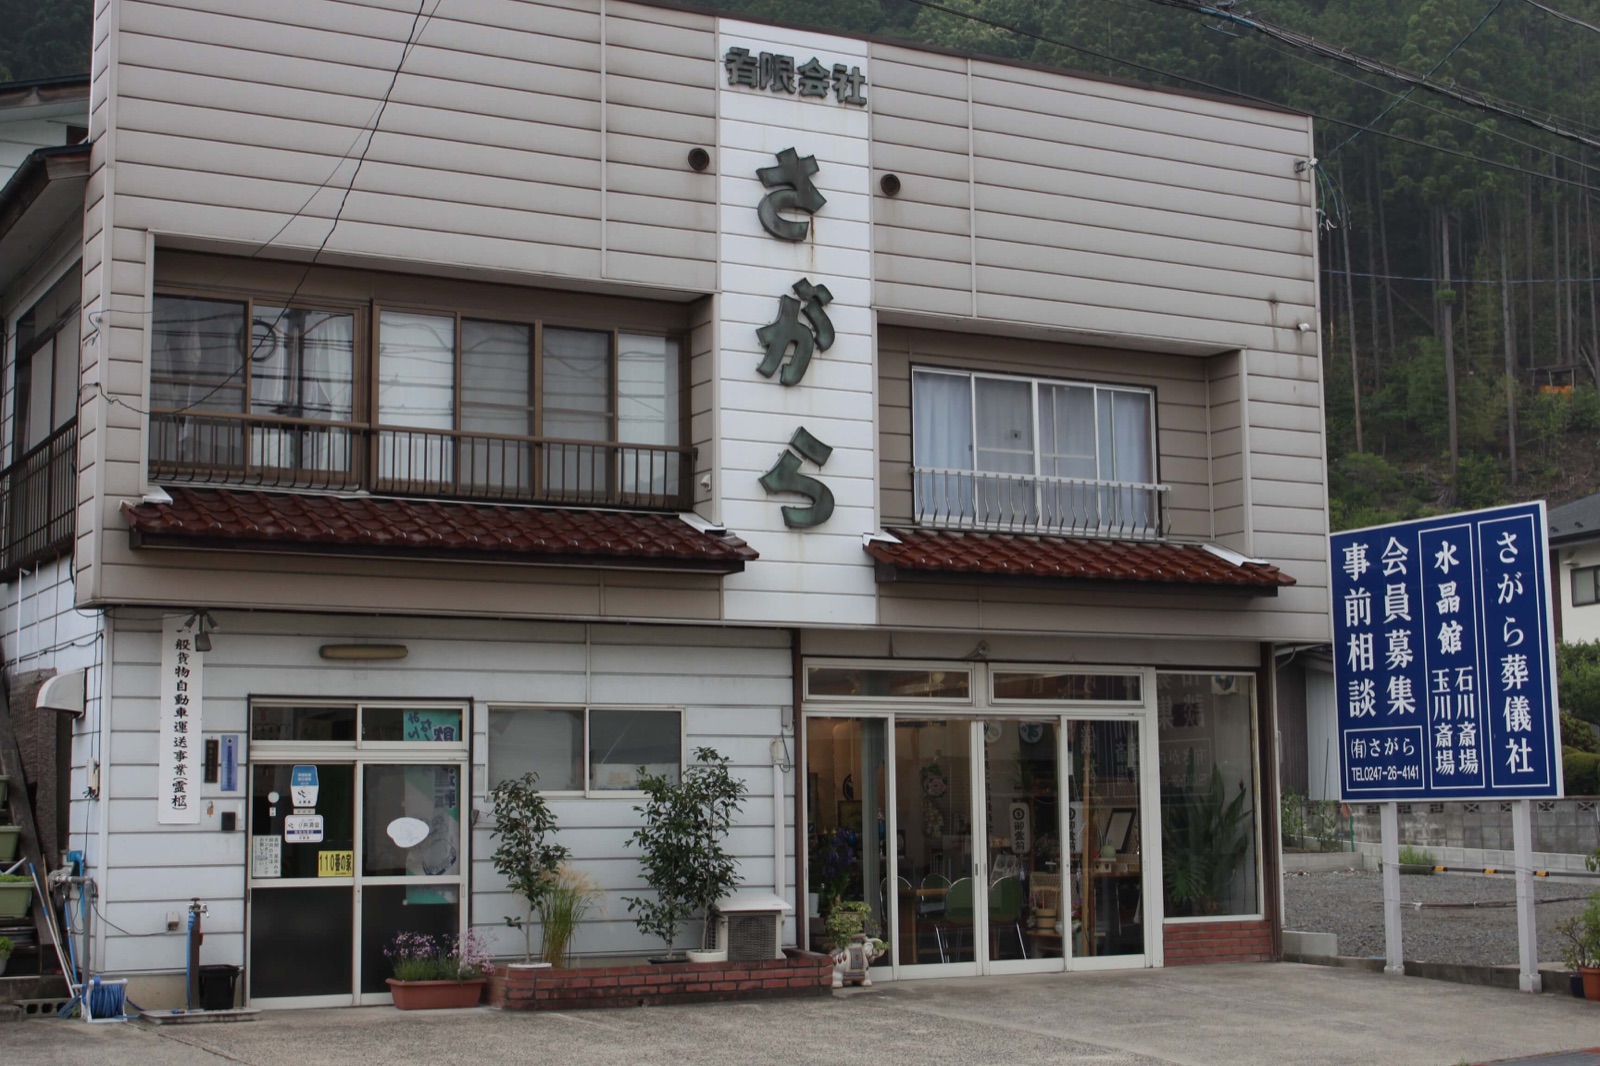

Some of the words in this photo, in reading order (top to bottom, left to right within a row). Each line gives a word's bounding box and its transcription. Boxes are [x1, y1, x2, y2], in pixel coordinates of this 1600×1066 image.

[725, 46, 868, 106] 有限会社
[755, 146, 836, 529] さがら
[1342, 542, 1377, 719] 事前相談
[1380, 536, 1416, 717] 会員募集
[1433, 540, 1463, 656] 水晶館
[1496, 531, 1534, 774] さがら葬儀社
[1351, 765, 1419, 782] TEL0247-26-4141
[1431, 668, 1455, 776] 玉川斎場
[1454, 665, 1479, 775] 石川斎場
[319, 853, 352, 872] 110番の家
